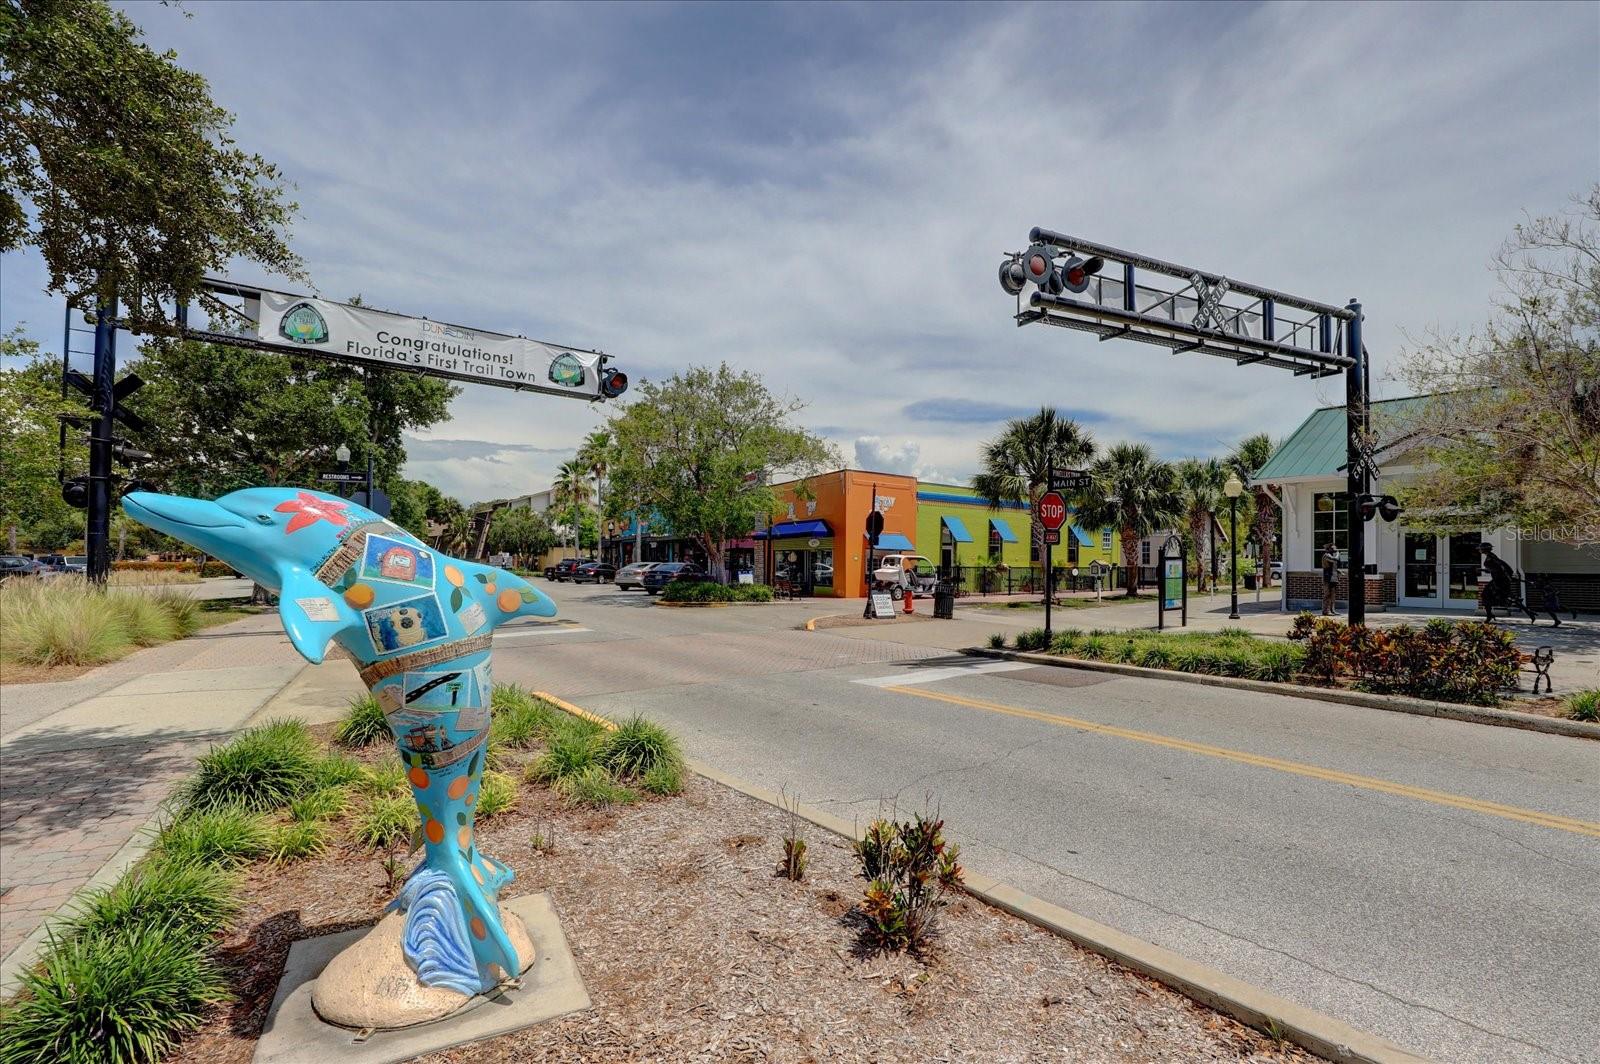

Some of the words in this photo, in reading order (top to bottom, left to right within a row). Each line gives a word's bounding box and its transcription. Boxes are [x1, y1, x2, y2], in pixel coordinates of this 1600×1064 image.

[1192, 273, 1207, 300] RAIL
[1212, 308, 1231, 333] ROAD
[1194, 278, 1230, 329] CROSSING
[346, 341, 421, 363] Florida's
[427, 354, 458, 370] First
[463, 360, 494, 376] Trail
[499, 366, 536, 382] Town
[376, 331, 513, 365] Congratulations!
[1053, 479, 1076, 488] MAIN
[1079, 478, 1091, 486] ST
[1041, 504, 1063, 518] STOP
